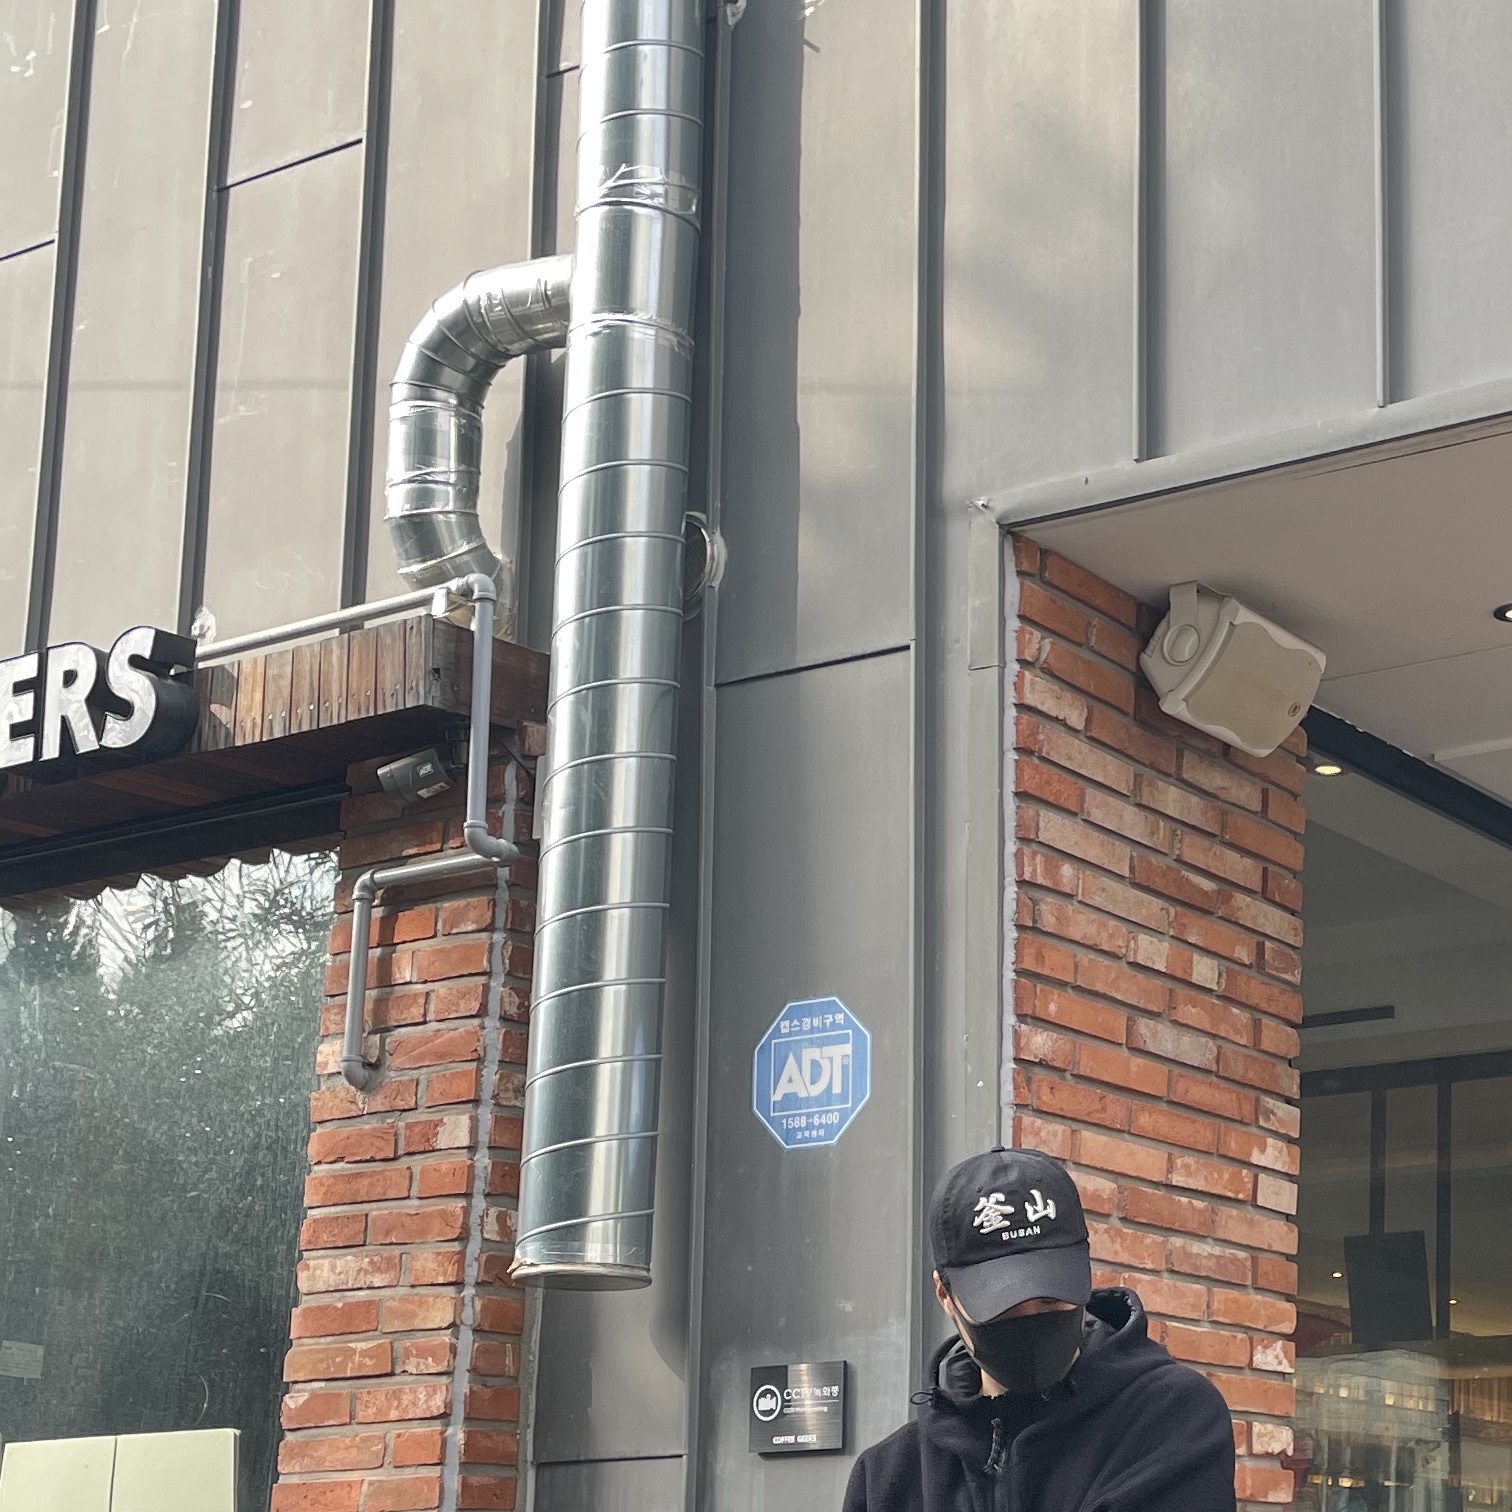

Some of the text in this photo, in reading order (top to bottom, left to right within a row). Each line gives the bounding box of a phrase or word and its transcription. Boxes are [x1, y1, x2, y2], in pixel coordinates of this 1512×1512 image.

[772, 1043, 851, 1101] ADT
[781, 1111, 840, 1130] 1588-6400
[1001, 1225, 1041, 1241] BUSAN
